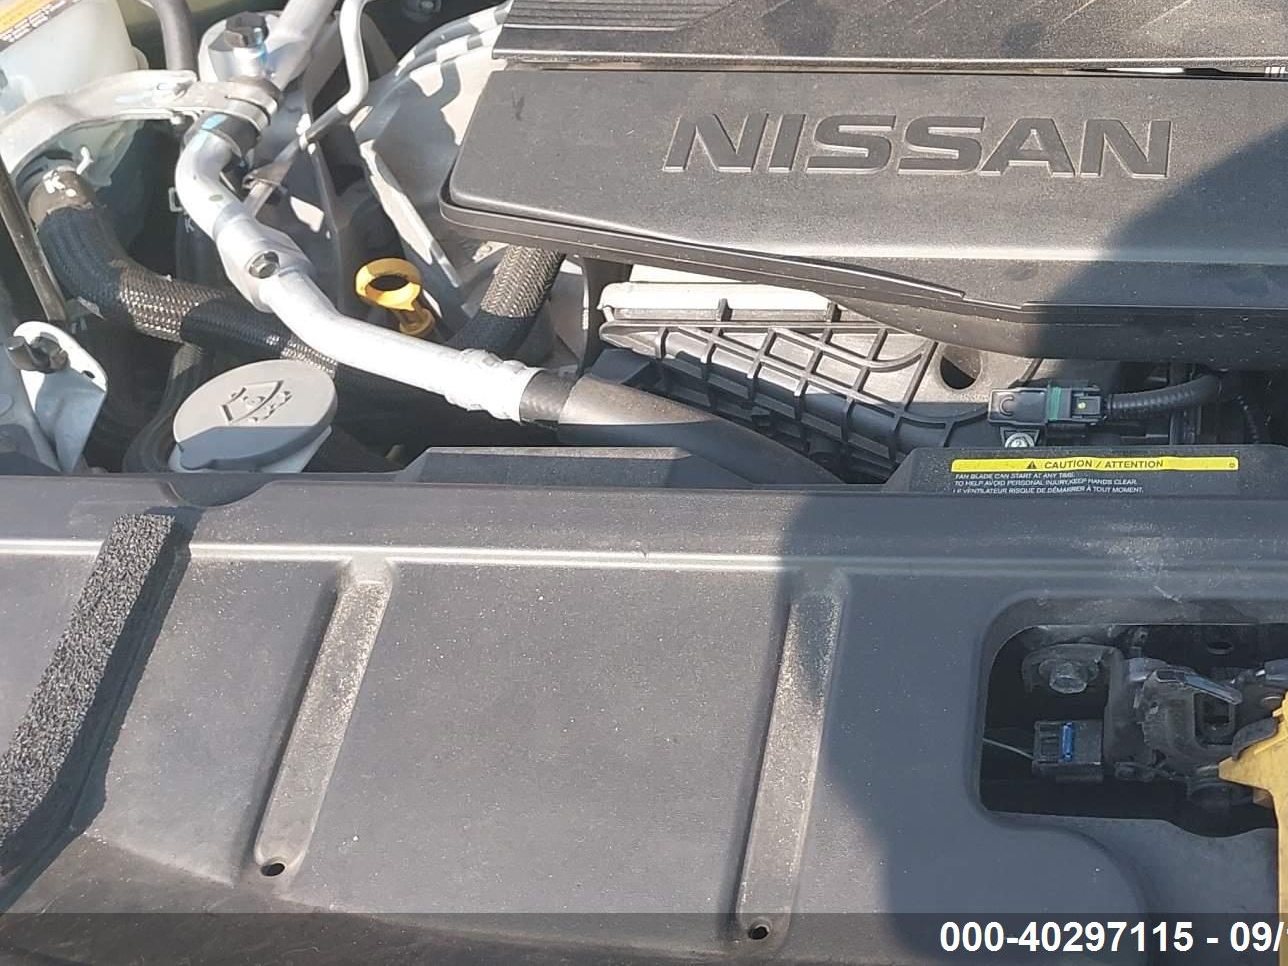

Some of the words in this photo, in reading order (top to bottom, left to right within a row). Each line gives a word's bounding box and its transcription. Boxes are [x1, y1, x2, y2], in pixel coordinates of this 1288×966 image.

[662, 113, 1173, 178] NISSAN
[1044, 460, 1093, 469] CAUTION
[1104, 460, 1164, 469] ATTENTION
